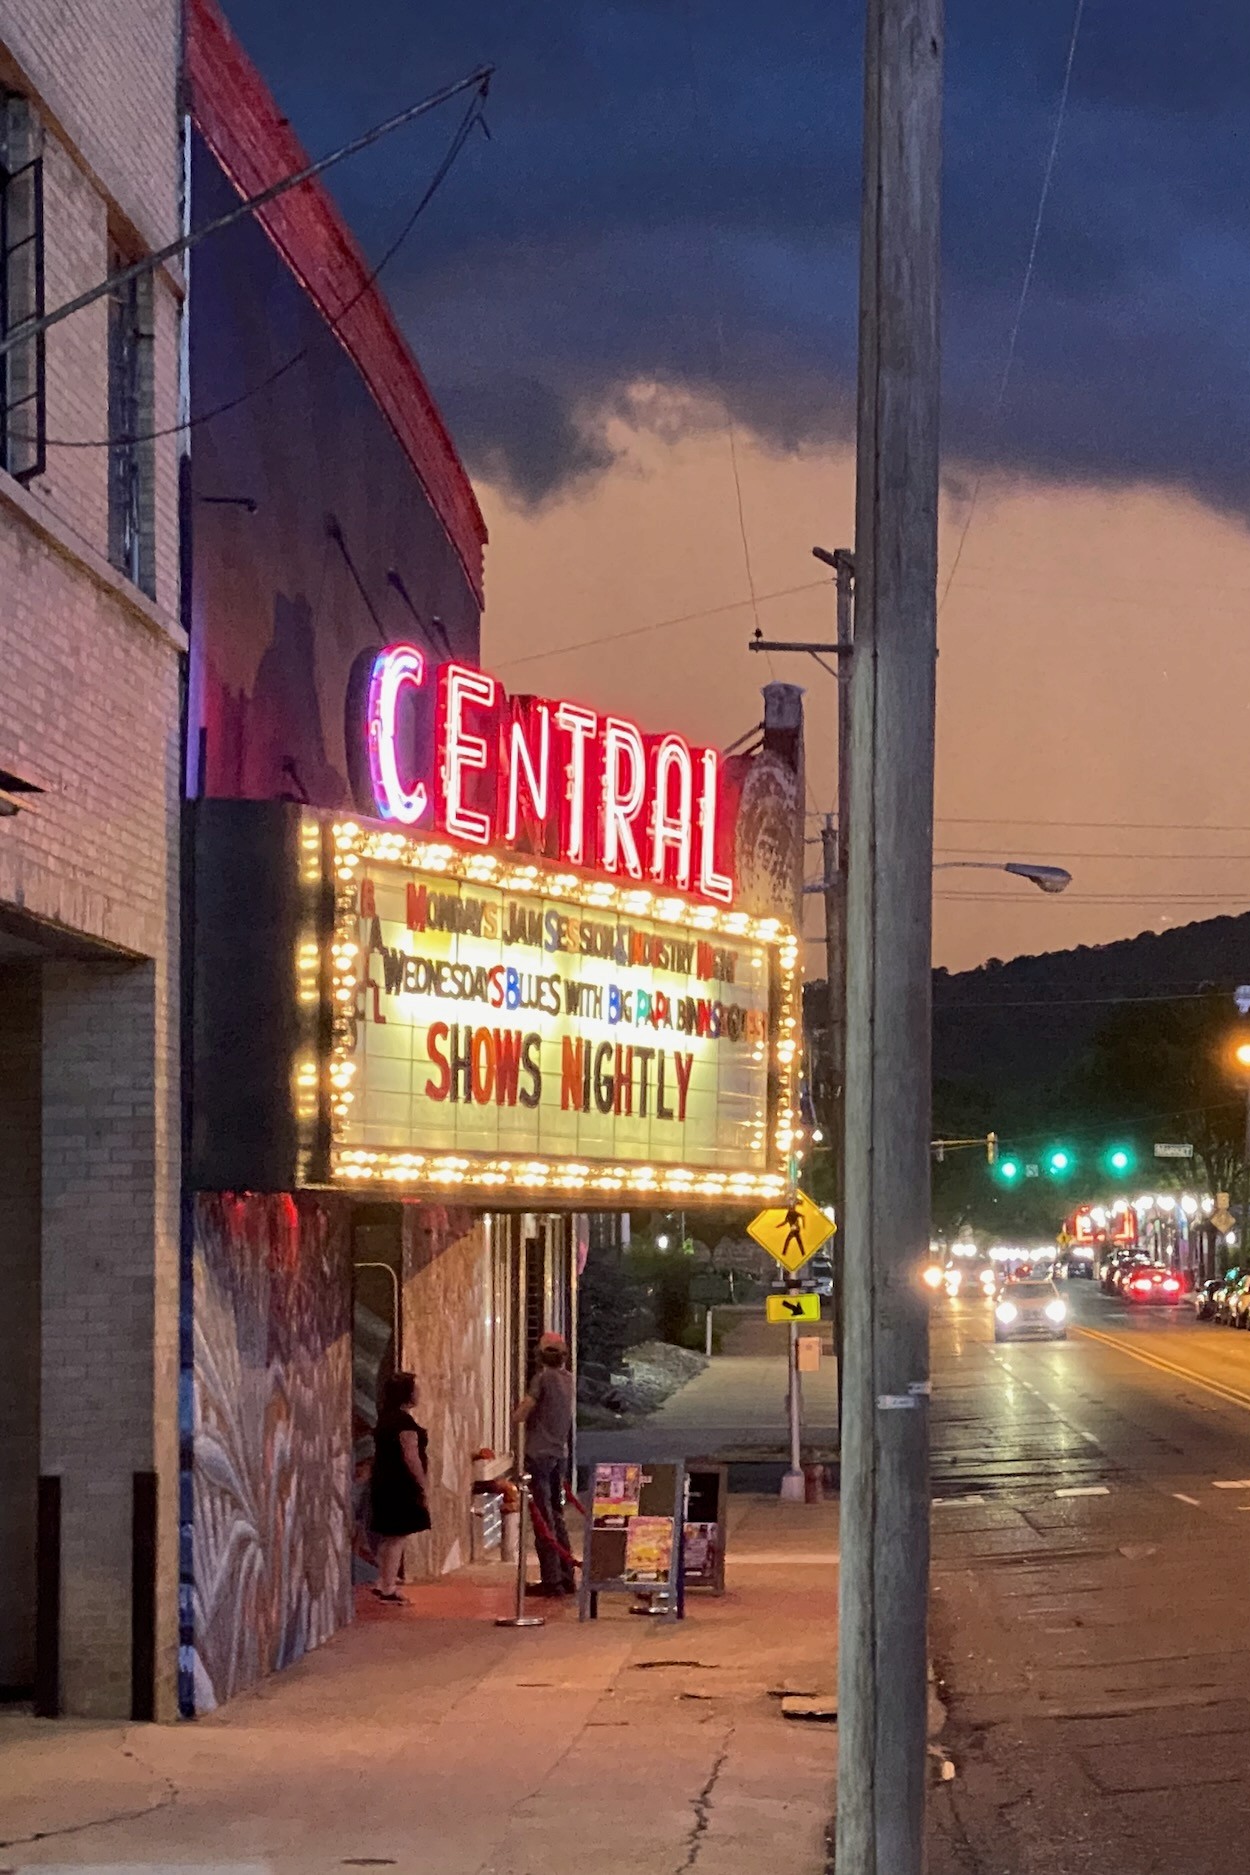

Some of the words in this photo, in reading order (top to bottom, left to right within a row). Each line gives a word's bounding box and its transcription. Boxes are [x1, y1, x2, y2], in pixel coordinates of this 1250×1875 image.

[368, 643, 733, 904] CENTRAL
[506, 966, 561, 1016] BLUES
[563, 978, 603, 1020] WITH
[608, 983, 633, 1025] BIG
[636, 988, 673, 1031] PAPA
[425, 1021, 542, 1109] SHOWS
[560, 1035, 694, 1121] NIGHTLY
